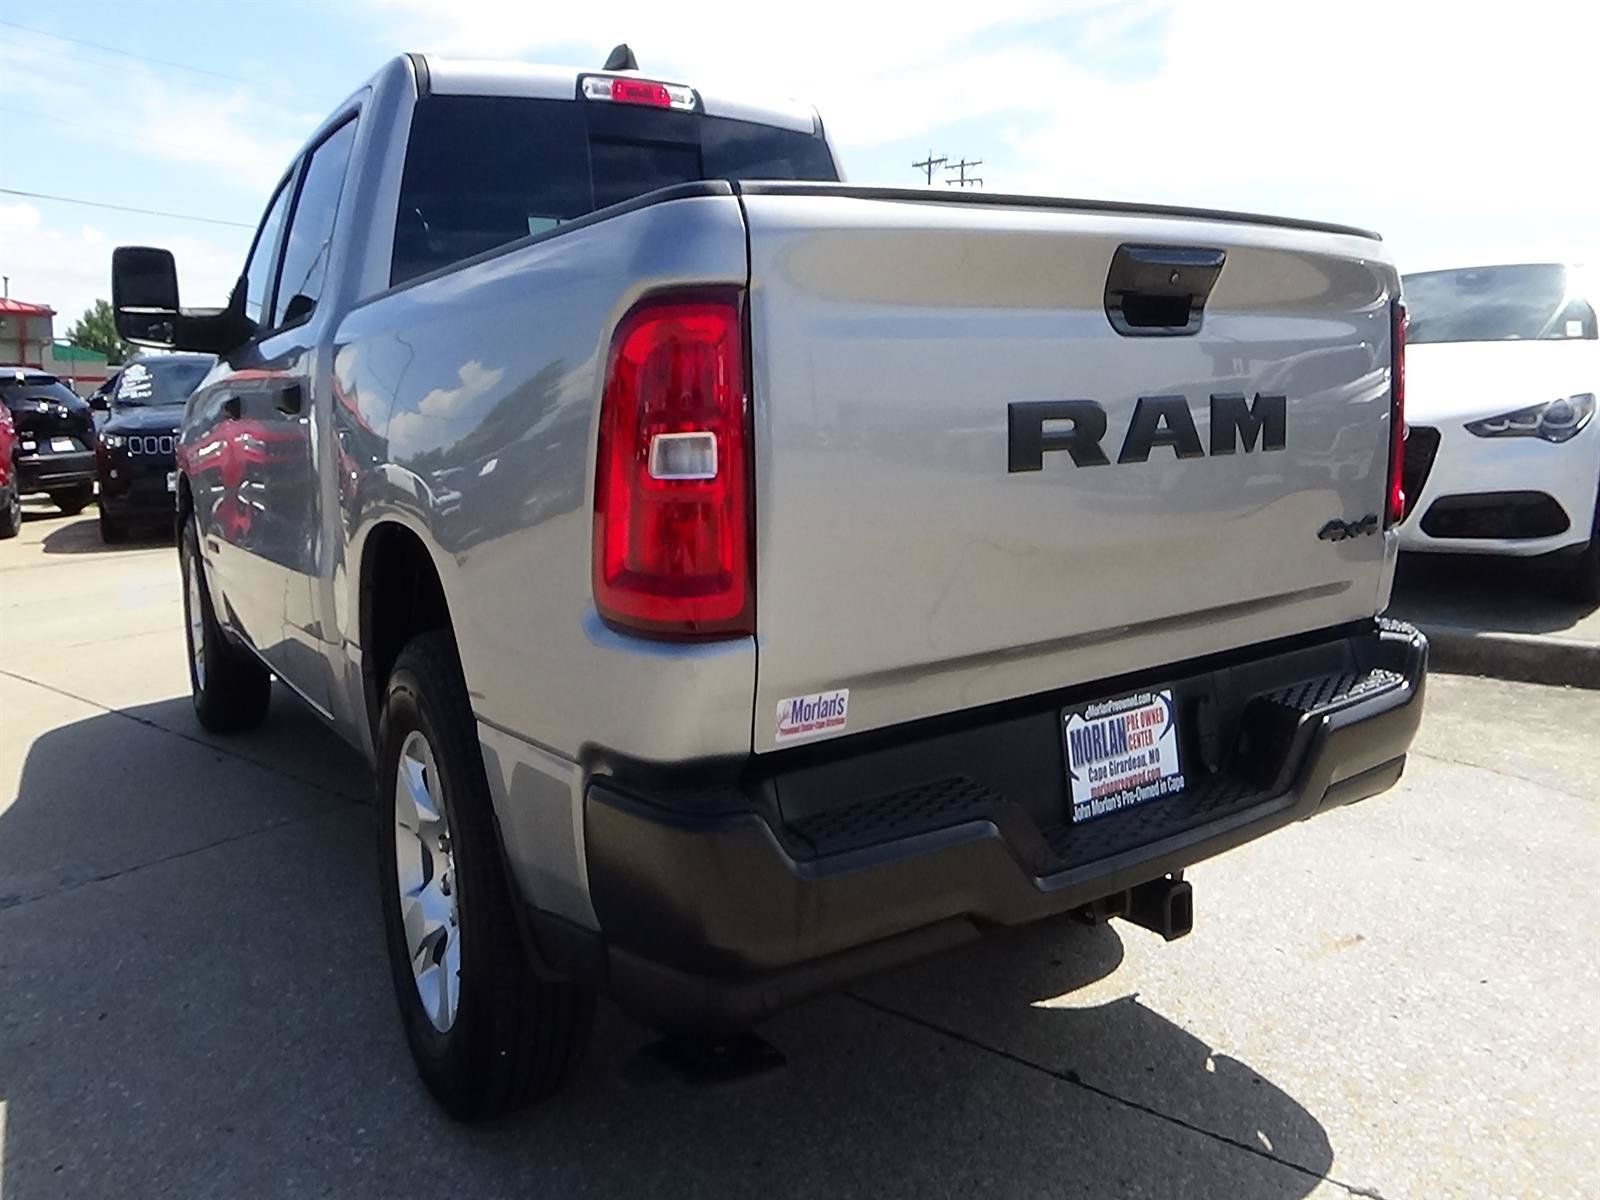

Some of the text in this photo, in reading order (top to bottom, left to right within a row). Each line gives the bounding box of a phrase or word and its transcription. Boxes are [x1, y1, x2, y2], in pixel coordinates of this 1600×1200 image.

[1007, 392, 1287, 474] RAM
[791, 693, 845, 724] Morlan's
[1126, 707, 1164, 731] PRE OWNED
[1070, 717, 1128, 768] MORLAN
[1128, 729, 1153, 751] CENTER
[1088, 764, 1107, 783] Cape
[1149, 748, 1161, 766] MO
[1073, 804, 1092, 822] John
[1121, 784, 1159, 806] Pre-Owned
[1159, 780, 1167, 793] in
[1167, 775, 1185, 793] Cape
